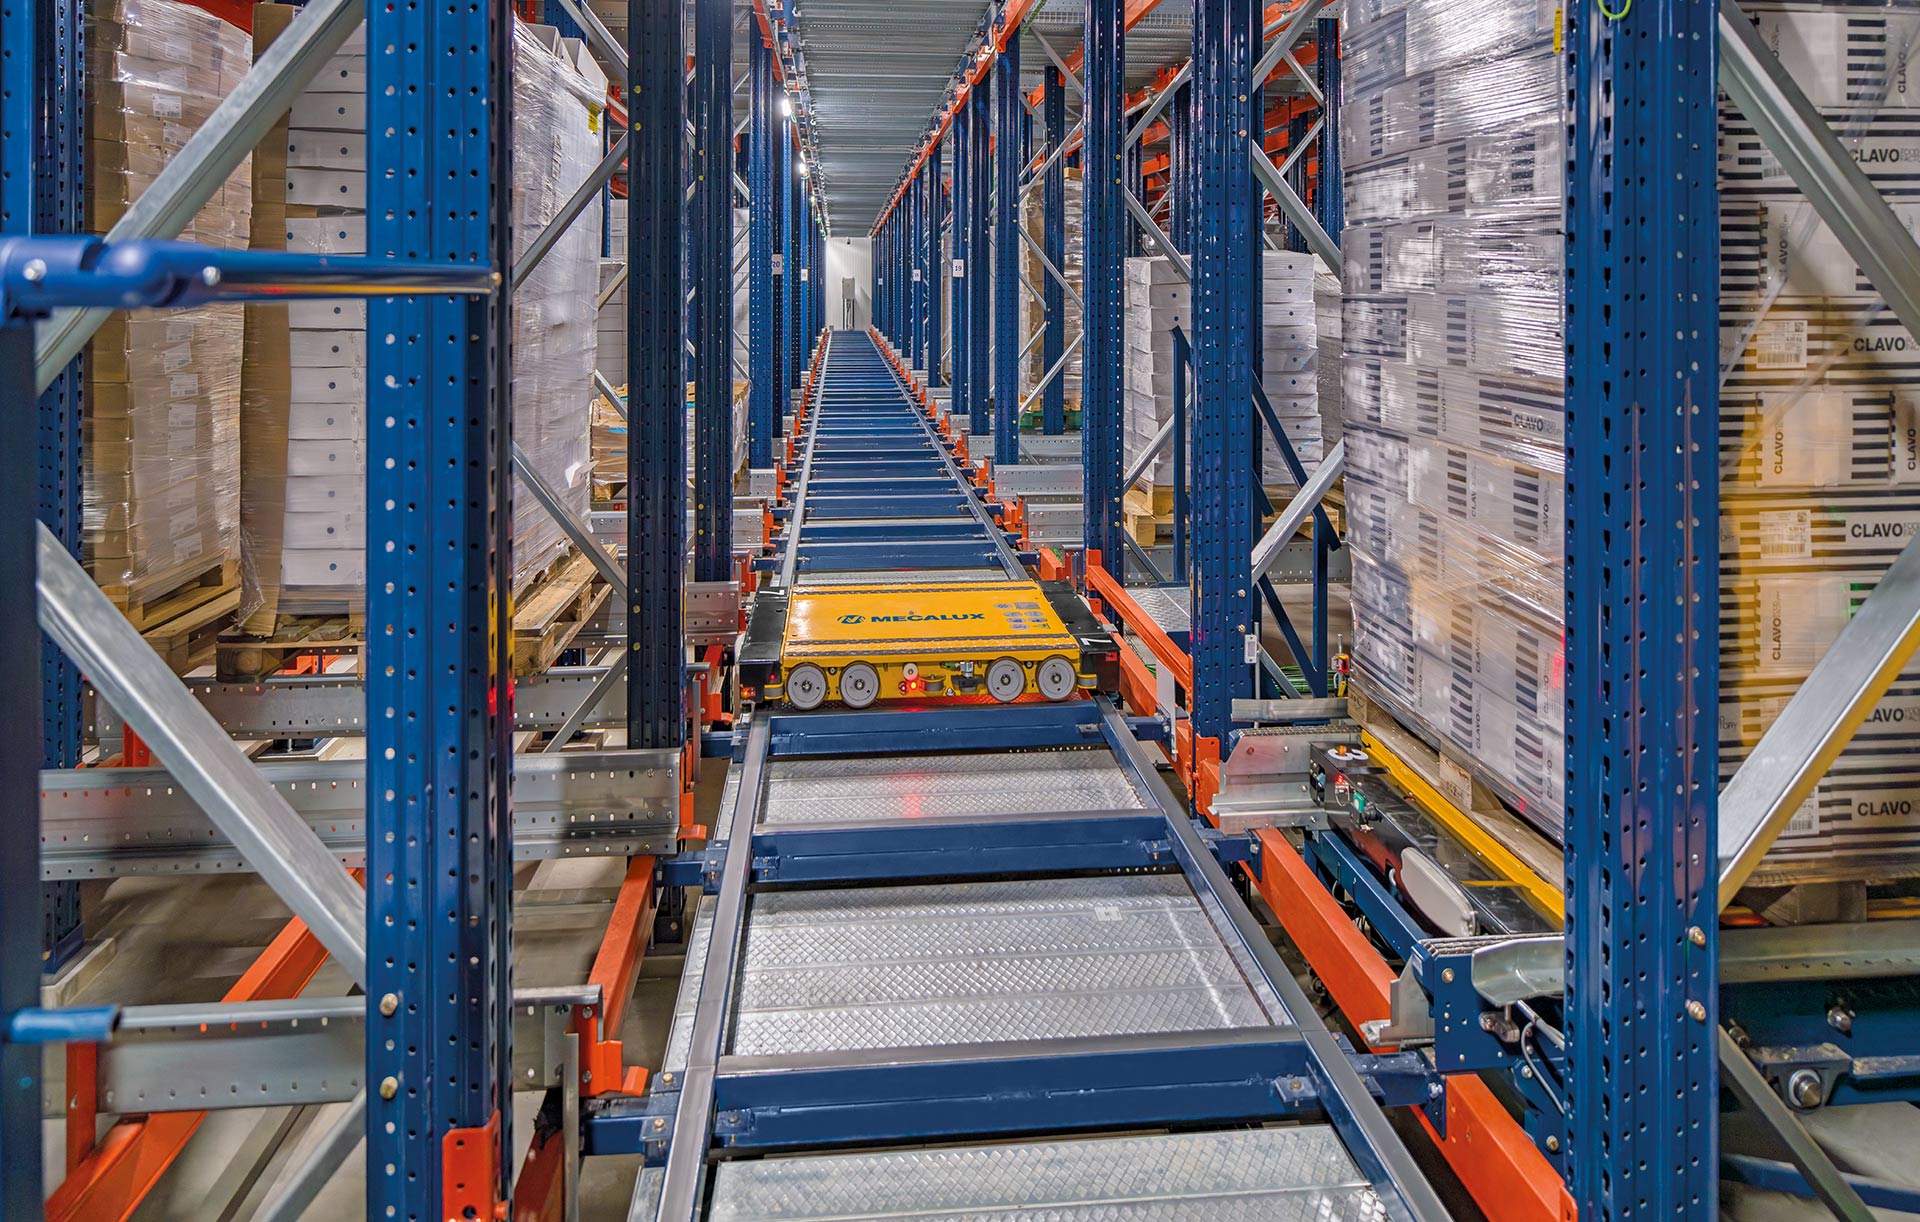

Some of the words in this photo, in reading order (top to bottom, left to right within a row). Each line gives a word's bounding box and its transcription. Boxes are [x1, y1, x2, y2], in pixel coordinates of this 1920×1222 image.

[1854, 337, 1906, 351] CLAVO
[1514, 415, 1544, 431] CLAVO
[1774, 431, 1784, 475] CLAVO
[1907, 428, 1917, 471] CLAVO
[1851, 523, 1903, 538] CLAVO
[871, 613, 985, 622] MECALUX
[1772, 618, 1782, 661] CLAVO
[1857, 801, 1912, 816] CLAVO
